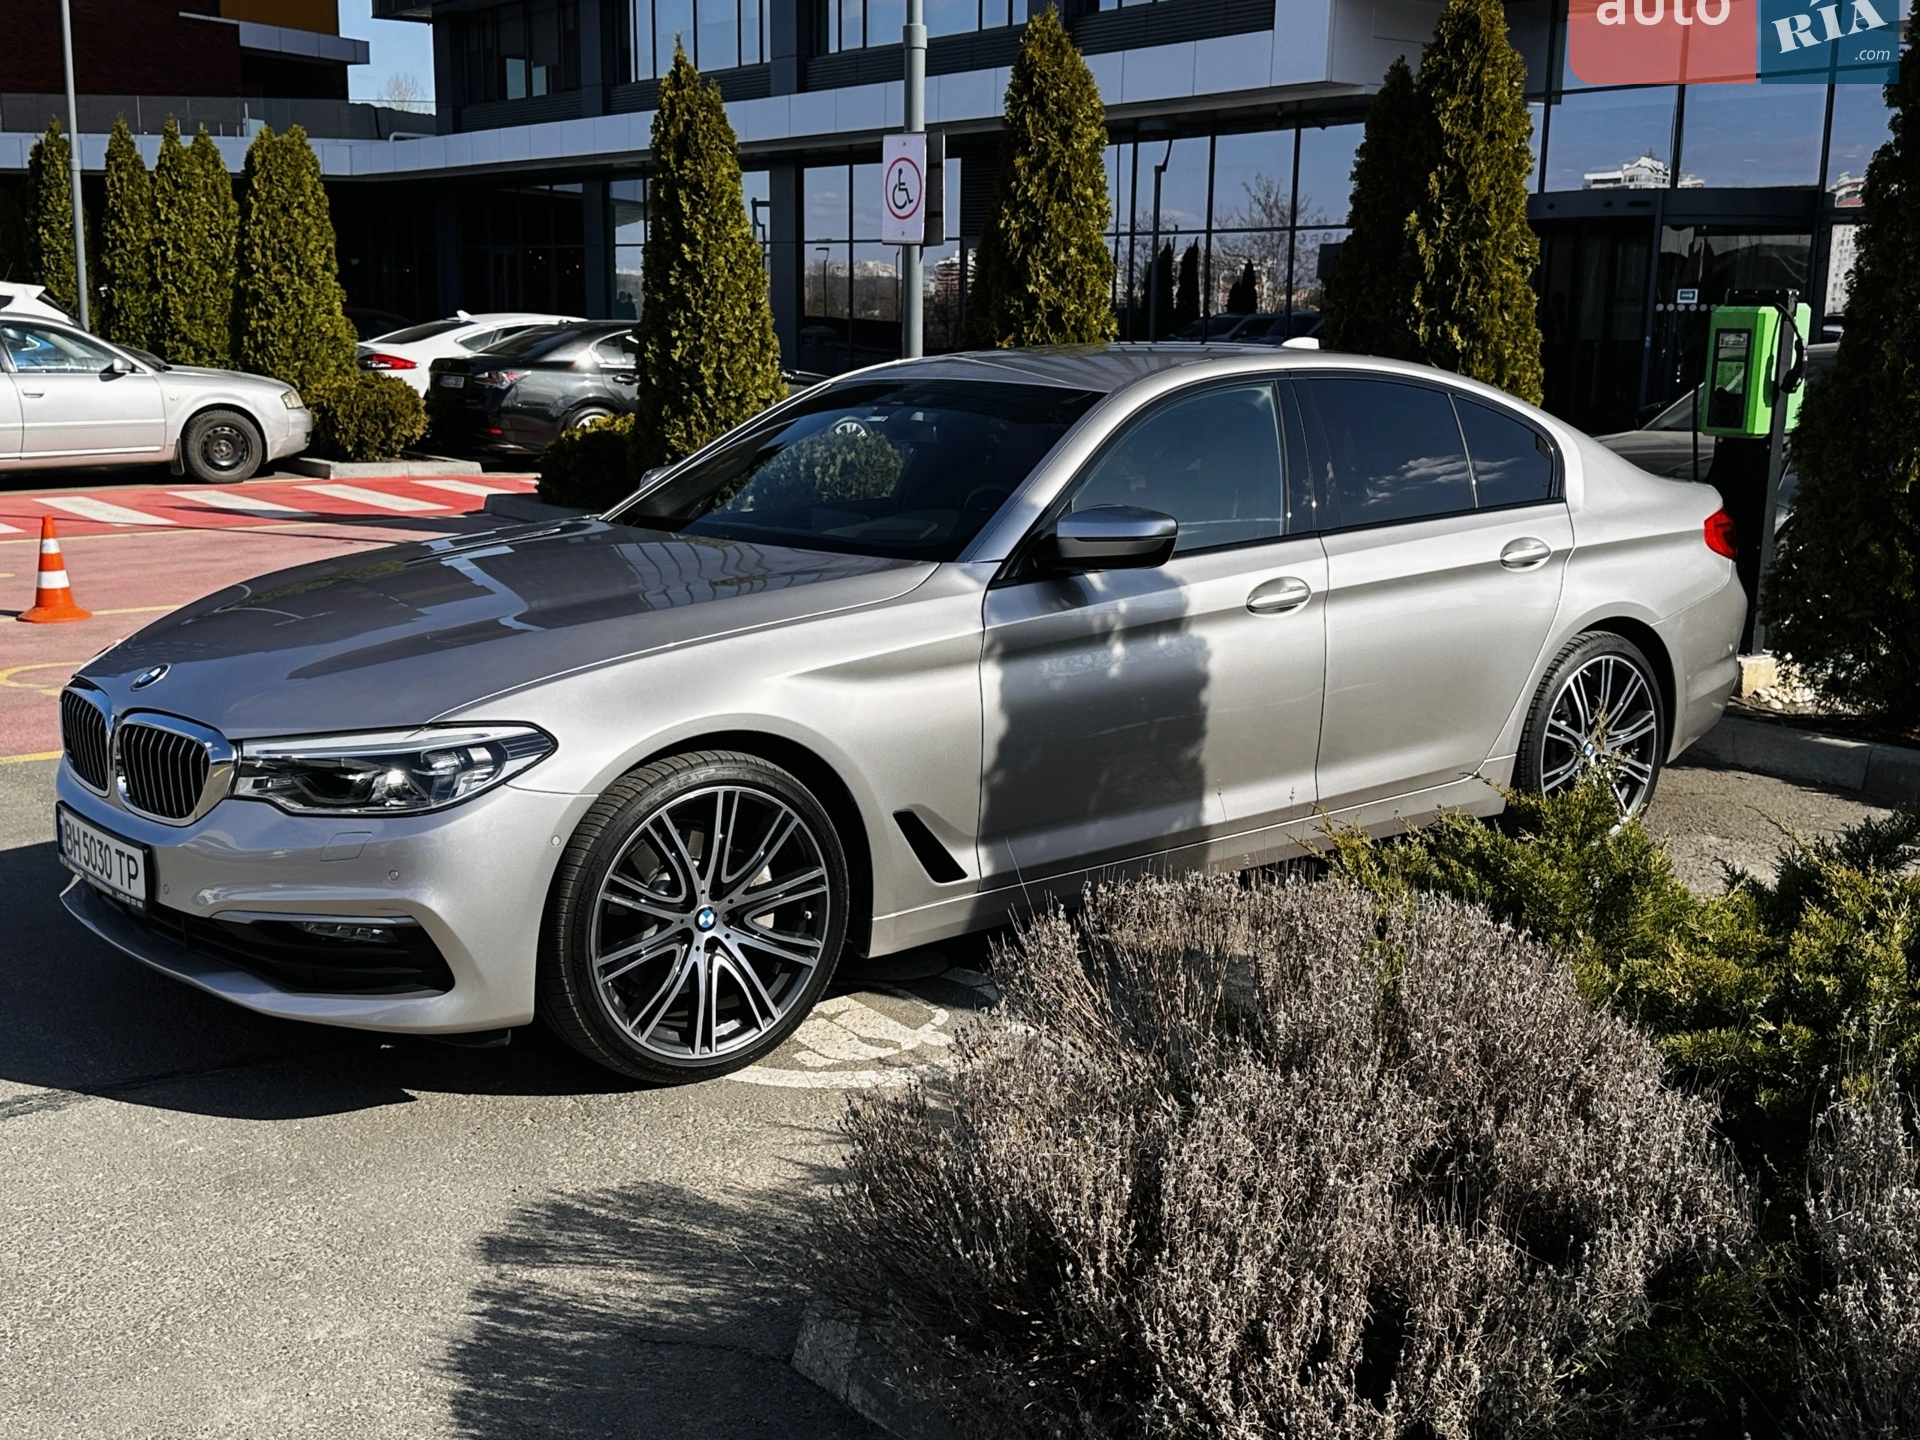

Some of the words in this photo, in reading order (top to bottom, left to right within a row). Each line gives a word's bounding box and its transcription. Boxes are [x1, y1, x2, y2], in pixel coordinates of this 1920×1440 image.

[64, 819, 81, 863] BH
[83, 831, 112, 880] 5030
[115, 848, 139, 890] TP
